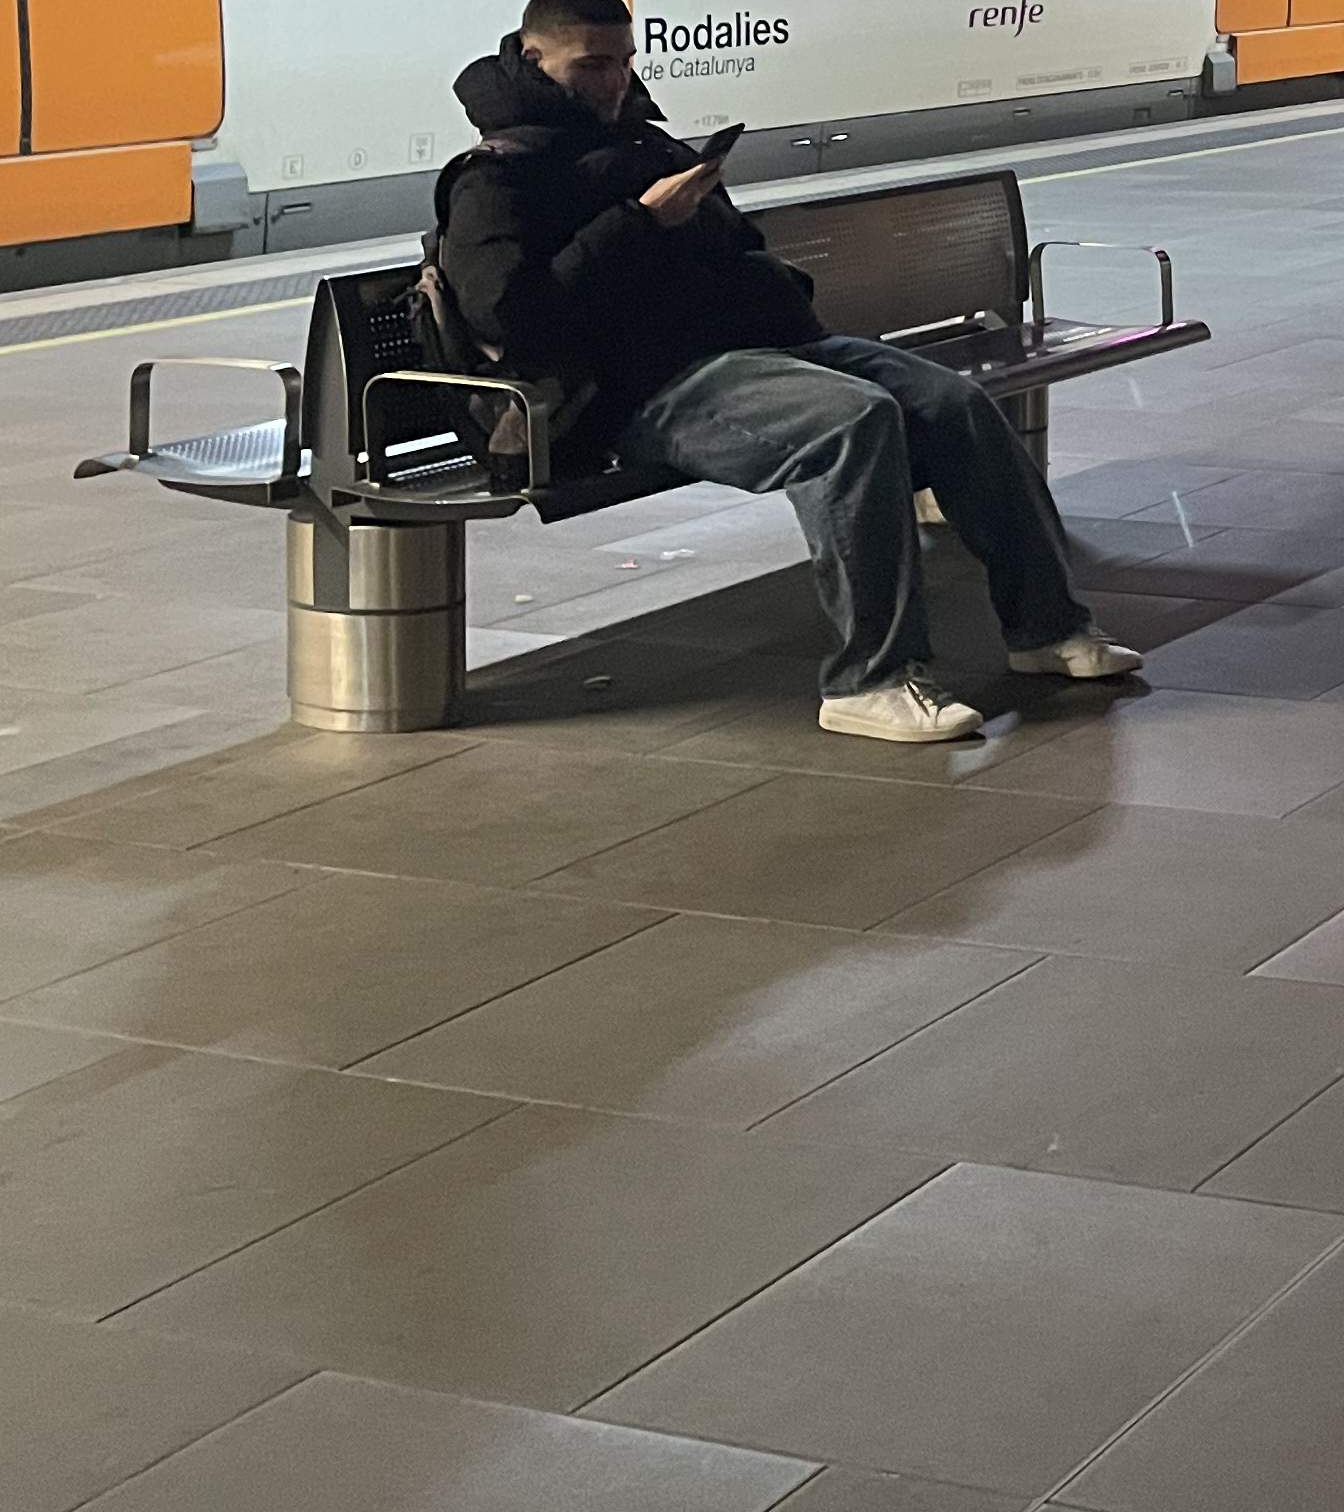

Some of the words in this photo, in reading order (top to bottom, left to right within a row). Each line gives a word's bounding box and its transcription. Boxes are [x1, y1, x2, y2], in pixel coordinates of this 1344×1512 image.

[644, 11, 790, 55] Rodalies
[641, 60, 665, 82] de
[669, 55, 755, 79] Catalunya
